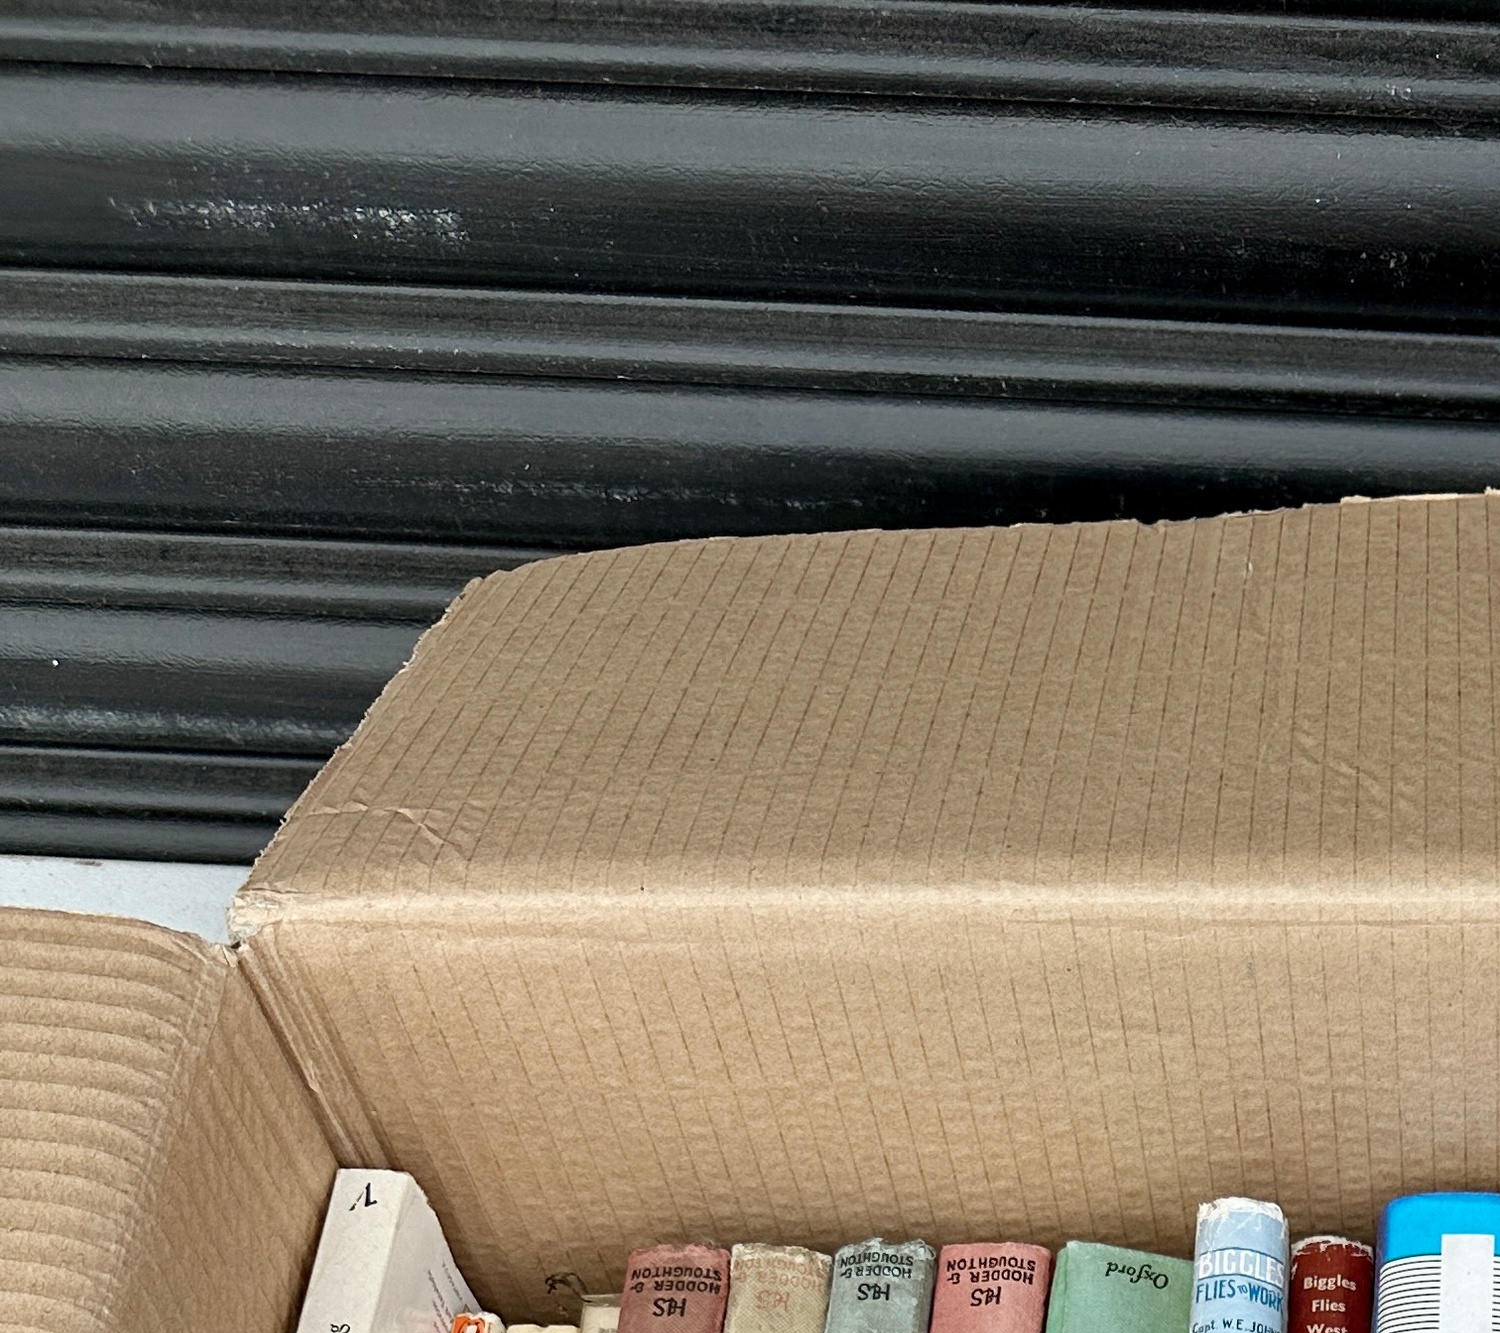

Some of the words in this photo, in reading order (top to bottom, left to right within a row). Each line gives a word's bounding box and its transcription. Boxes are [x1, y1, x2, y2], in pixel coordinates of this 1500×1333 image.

[1105, 1261, 1169, 1289] Oxford
[1303, 1276, 1356, 1291] Biggles
[1196, 1280, 1235, 1303] FLIES
[1312, 1299, 1346, 1312] Flies
